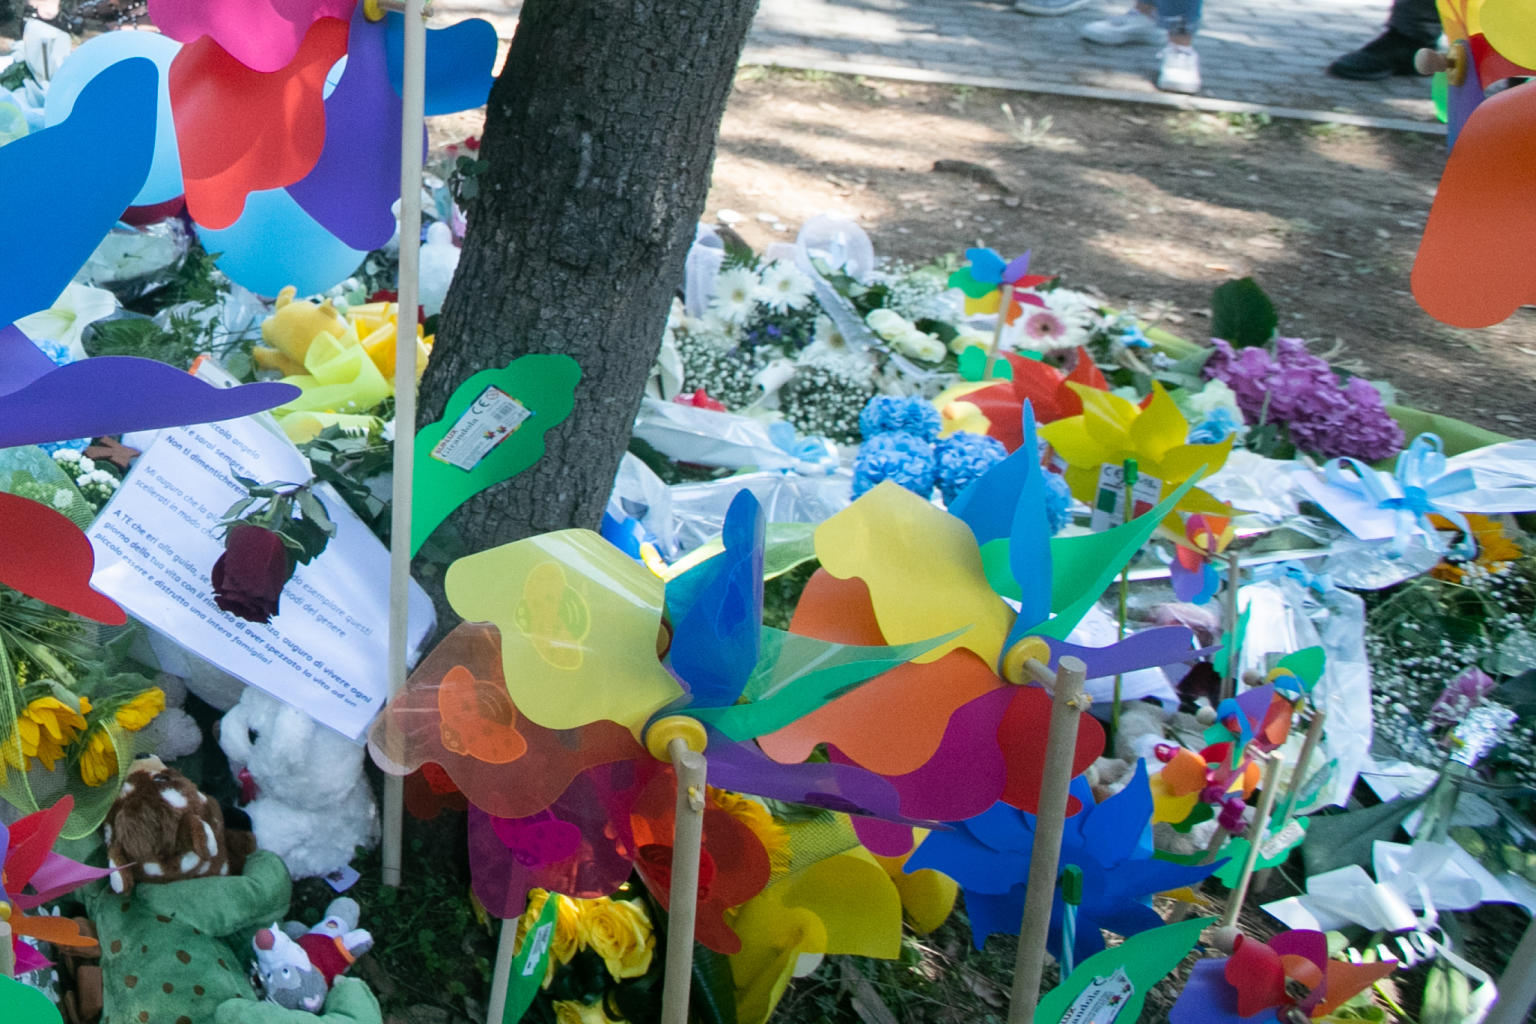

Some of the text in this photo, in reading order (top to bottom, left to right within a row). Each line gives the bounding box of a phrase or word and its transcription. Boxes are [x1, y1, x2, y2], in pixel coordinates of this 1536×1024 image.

[164, 434, 184, 451] Non
[181, 446, 191, 456] ti
[188, 451, 251, 499] dimenticherem
[187, 429, 196, 438] e
[193, 432, 217, 452] sarai
[212, 446, 246, 473] sempre
[230, 435, 261, 461] angelo
[93, 530, 124, 556] piccolo
[120, 553, 149, 578] essere
[146, 573, 156, 582] e
[153, 576, 191, 608] distrutto
[188, 604, 207, 621] una
[205, 615, 233, 639] intera
[230, 633, 272, 667] famiglia!
[102, 520, 131, 544] giorno
[128, 539, 151, 559] della
[149, 554, 166, 570] tua
[163, 566, 182, 583] vita
[179, 578, 197, 595] con
[195, 589, 205, 600] il
[201, 594, 236, 624] rimorso
[234, 618, 246, 631] di
[243, 627, 265, 645] aver
[263, 641, 303, 672] spezzato
[301, 667, 313, 679] la
[311, 675, 331, 691] vita
[330, 687, 345, 700] ad
[112, 507, 372, 705] A TE che eri alla guida, se auguro di vivere ogni
[134, 477, 171, 507] scellerati
[168, 501, 179, 513] in
[176, 507, 202, 530] modo
[301, 601, 318, 617] del
[315, 612, 347, 639] genere
[143, 464, 157, 478] Mi
[154, 473, 184, 498] auguro
[182, 491, 201, 509] che
[196, 502, 209, 515] la
[301, 581, 346, 618] esemplare
[344, 612, 373, 637] questi
